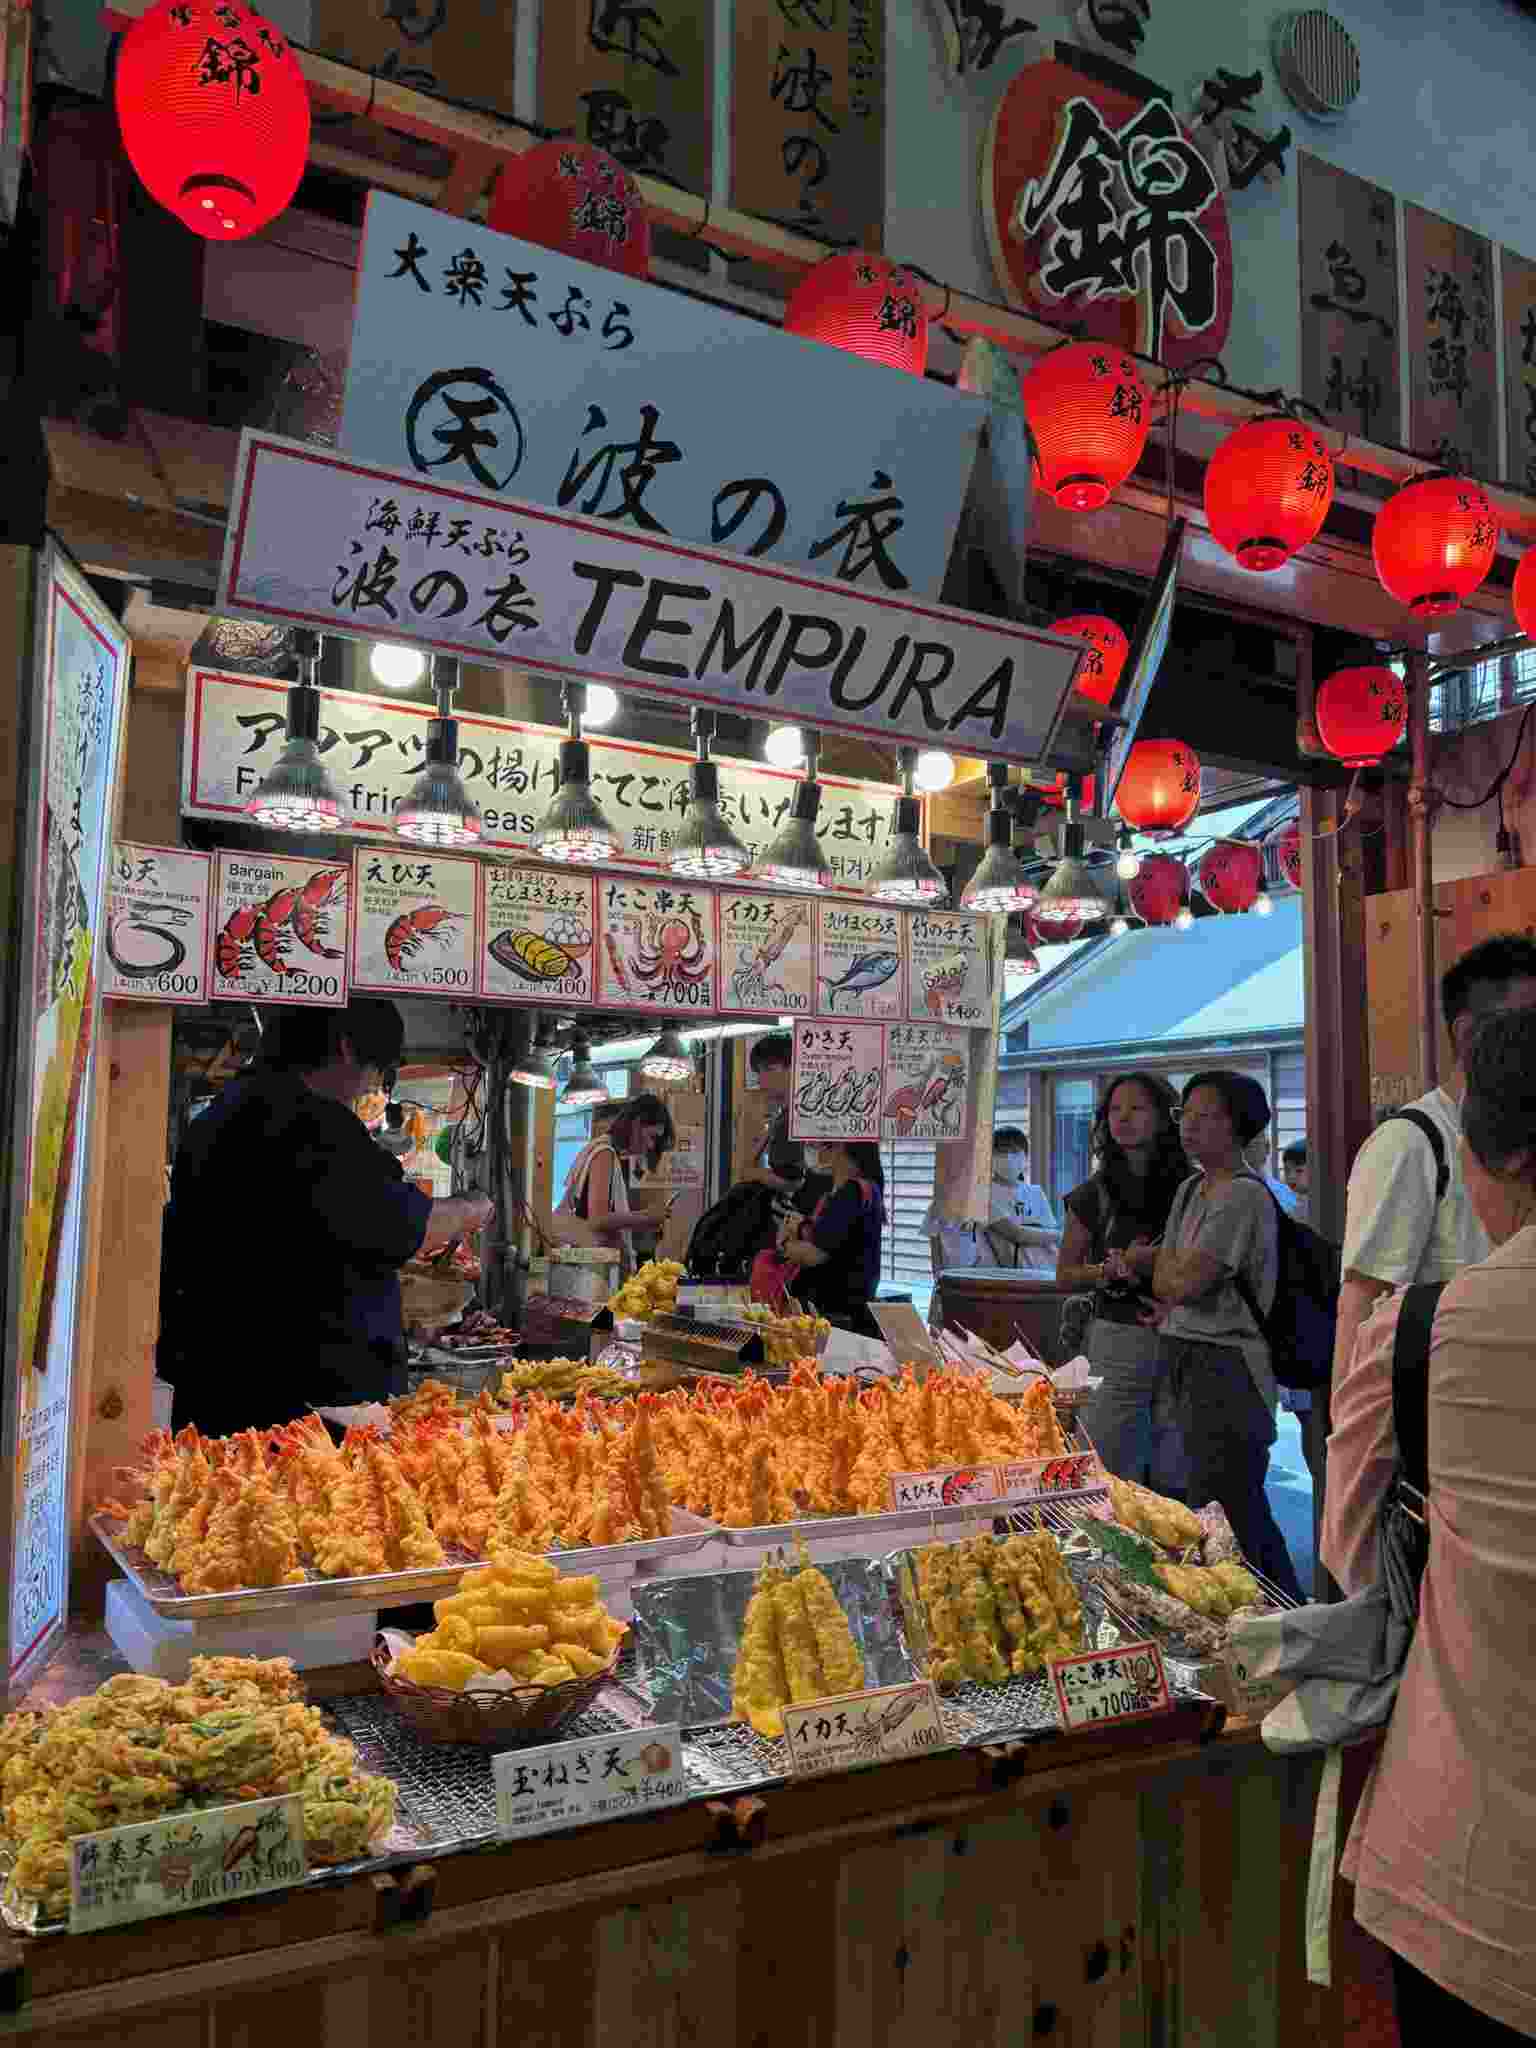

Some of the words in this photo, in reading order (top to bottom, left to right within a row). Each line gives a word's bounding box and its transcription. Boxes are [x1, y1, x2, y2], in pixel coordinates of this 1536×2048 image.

[191, 38, 261, 105] 錦
[1021, 97, 1217, 362] 錦
[875, 295, 917, 340] 錦
[1106, 384, 1143, 424] 錦
[557, 404, 909, 590] 波の衣
[364, 498, 532, 566] 海鮮天ぷら
[331, 540, 540, 643] 波の衣
[573, 561, 1016, 739] TEMPURA
[230, 863, 284, 881] Bargain
[367, 857, 435, 889] えび天
[606, 884, 702, 918] たこ串天
[725, 899, 779, 925] イカ天
[911, 915, 978, 944] 竹の子天
[802, 1029, 854, 1052] かき天
[1056, 1658, 1122, 1686] たこ串天
[794, 1712, 855, 1743] イカ天
[511, 1746, 629, 1797] 玉ねぎ天
